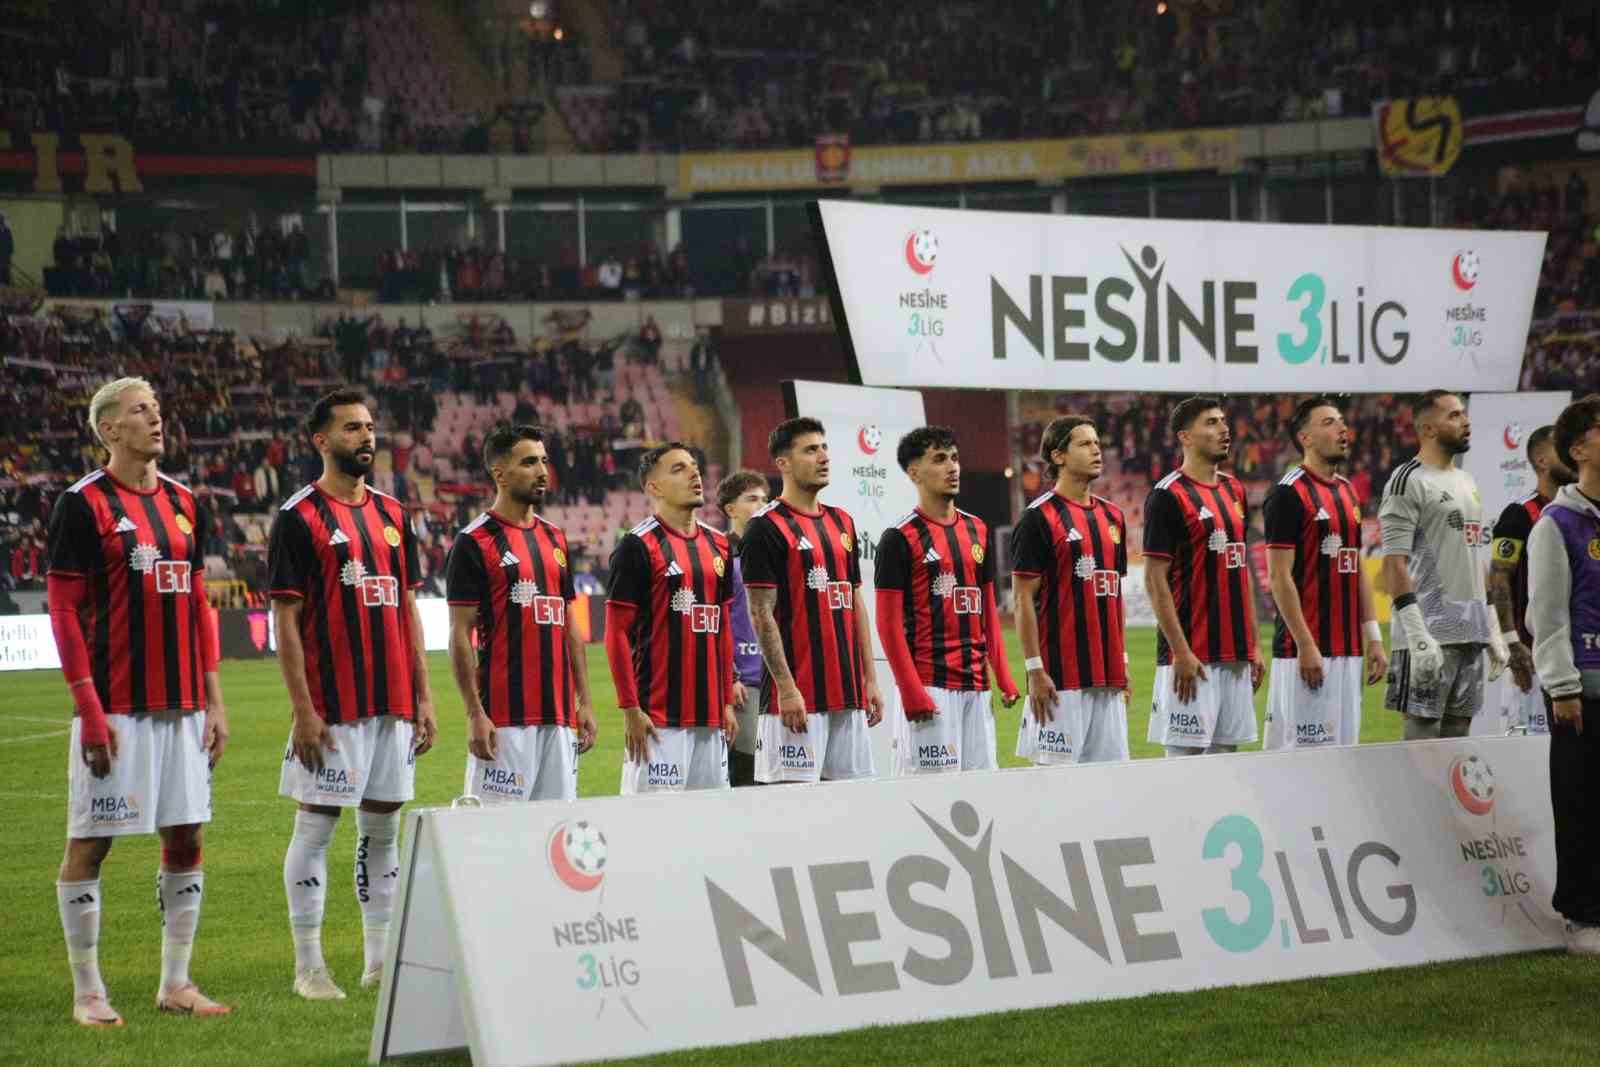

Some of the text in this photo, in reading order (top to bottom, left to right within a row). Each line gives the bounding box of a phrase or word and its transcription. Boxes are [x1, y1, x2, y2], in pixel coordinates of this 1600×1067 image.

[919, 745, 950, 759] MBA
[484, 767, 517, 787] MBA
[648, 763, 679, 777] MBA
[91, 796, 129, 813] MBA
